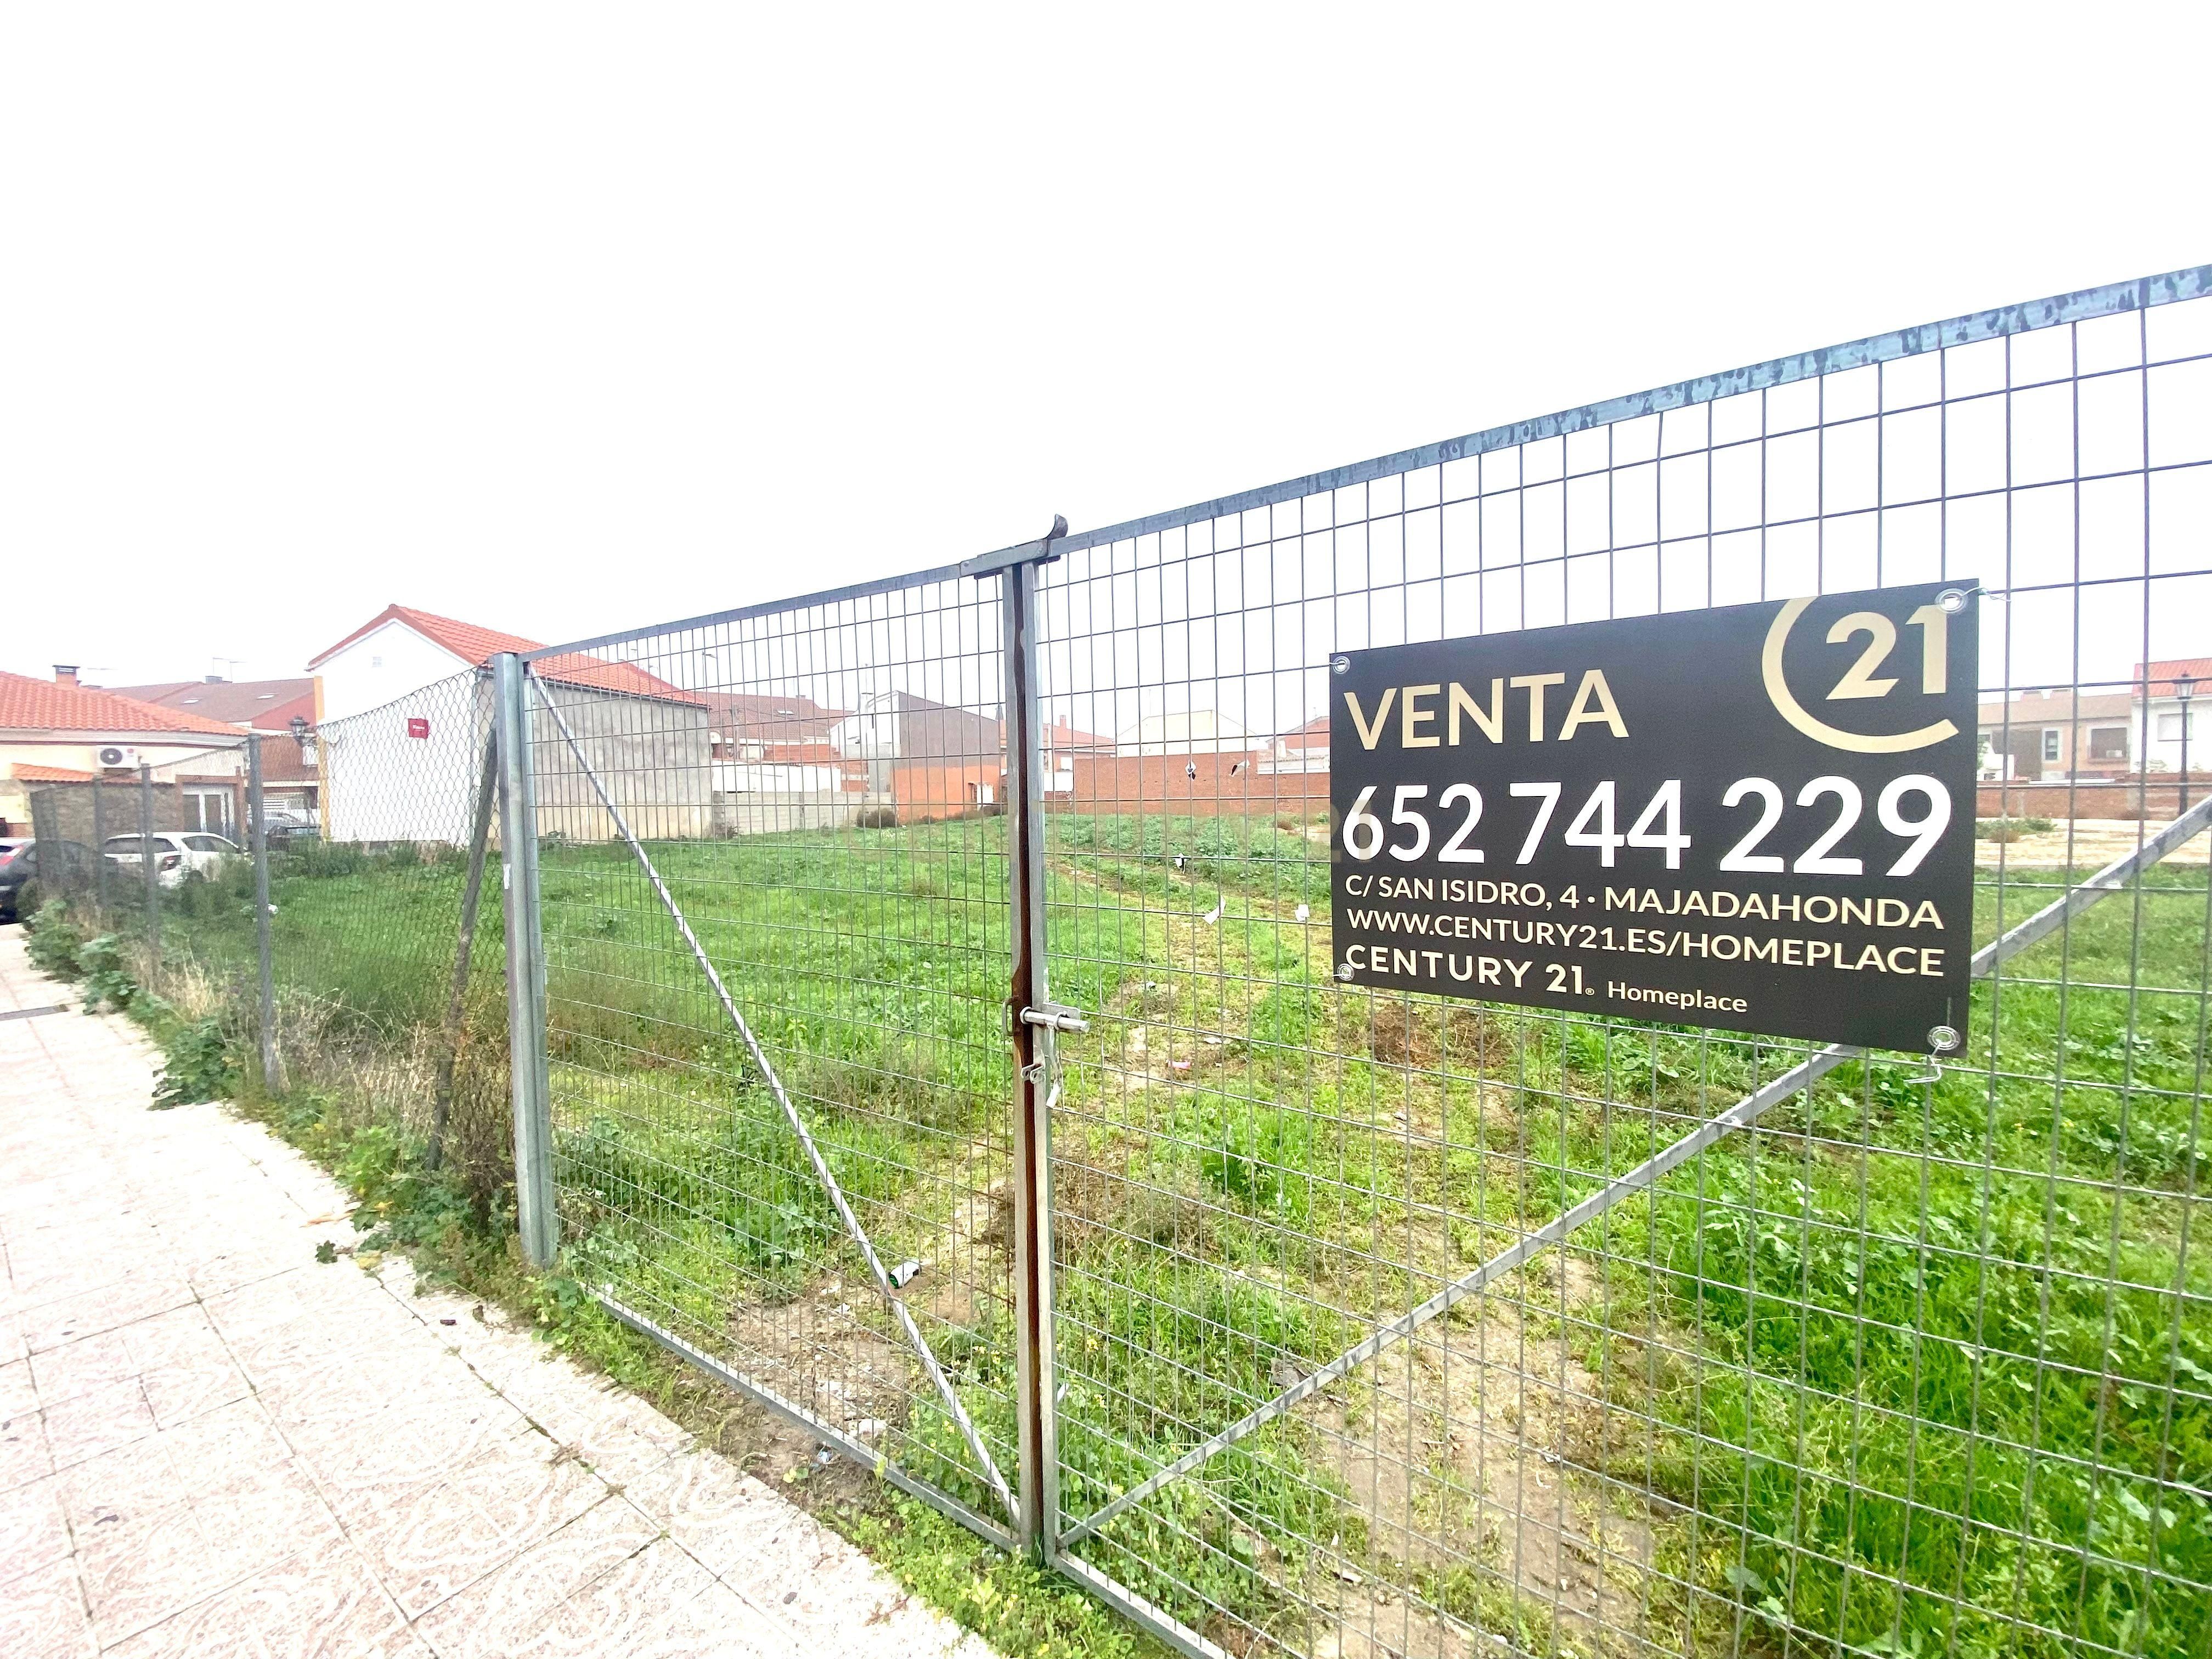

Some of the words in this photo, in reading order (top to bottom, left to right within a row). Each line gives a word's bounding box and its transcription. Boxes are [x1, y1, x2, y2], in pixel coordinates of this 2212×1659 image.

[1343, 669, 1629, 750] VENTA
[1342, 782, 1485, 864] 652
[1509, 779, 1691, 870] 744
[1719, 774, 1952, 877] 229
[1345, 874, 1374, 897] C/
[1378, 876, 1433, 900] SAN
[1442, 879, 1552, 911] ISIDRO,
[1559, 885, 1579, 909] 4
[1605, 887, 1945, 929] MAJADAHONDA
[1346, 908, 1945, 977] WWW.CENTURY21.ES/HOMEPLACE
[1345, 944, 1533, 988] CENTURY
[1608, 981, 1748, 1013] Homeplace
